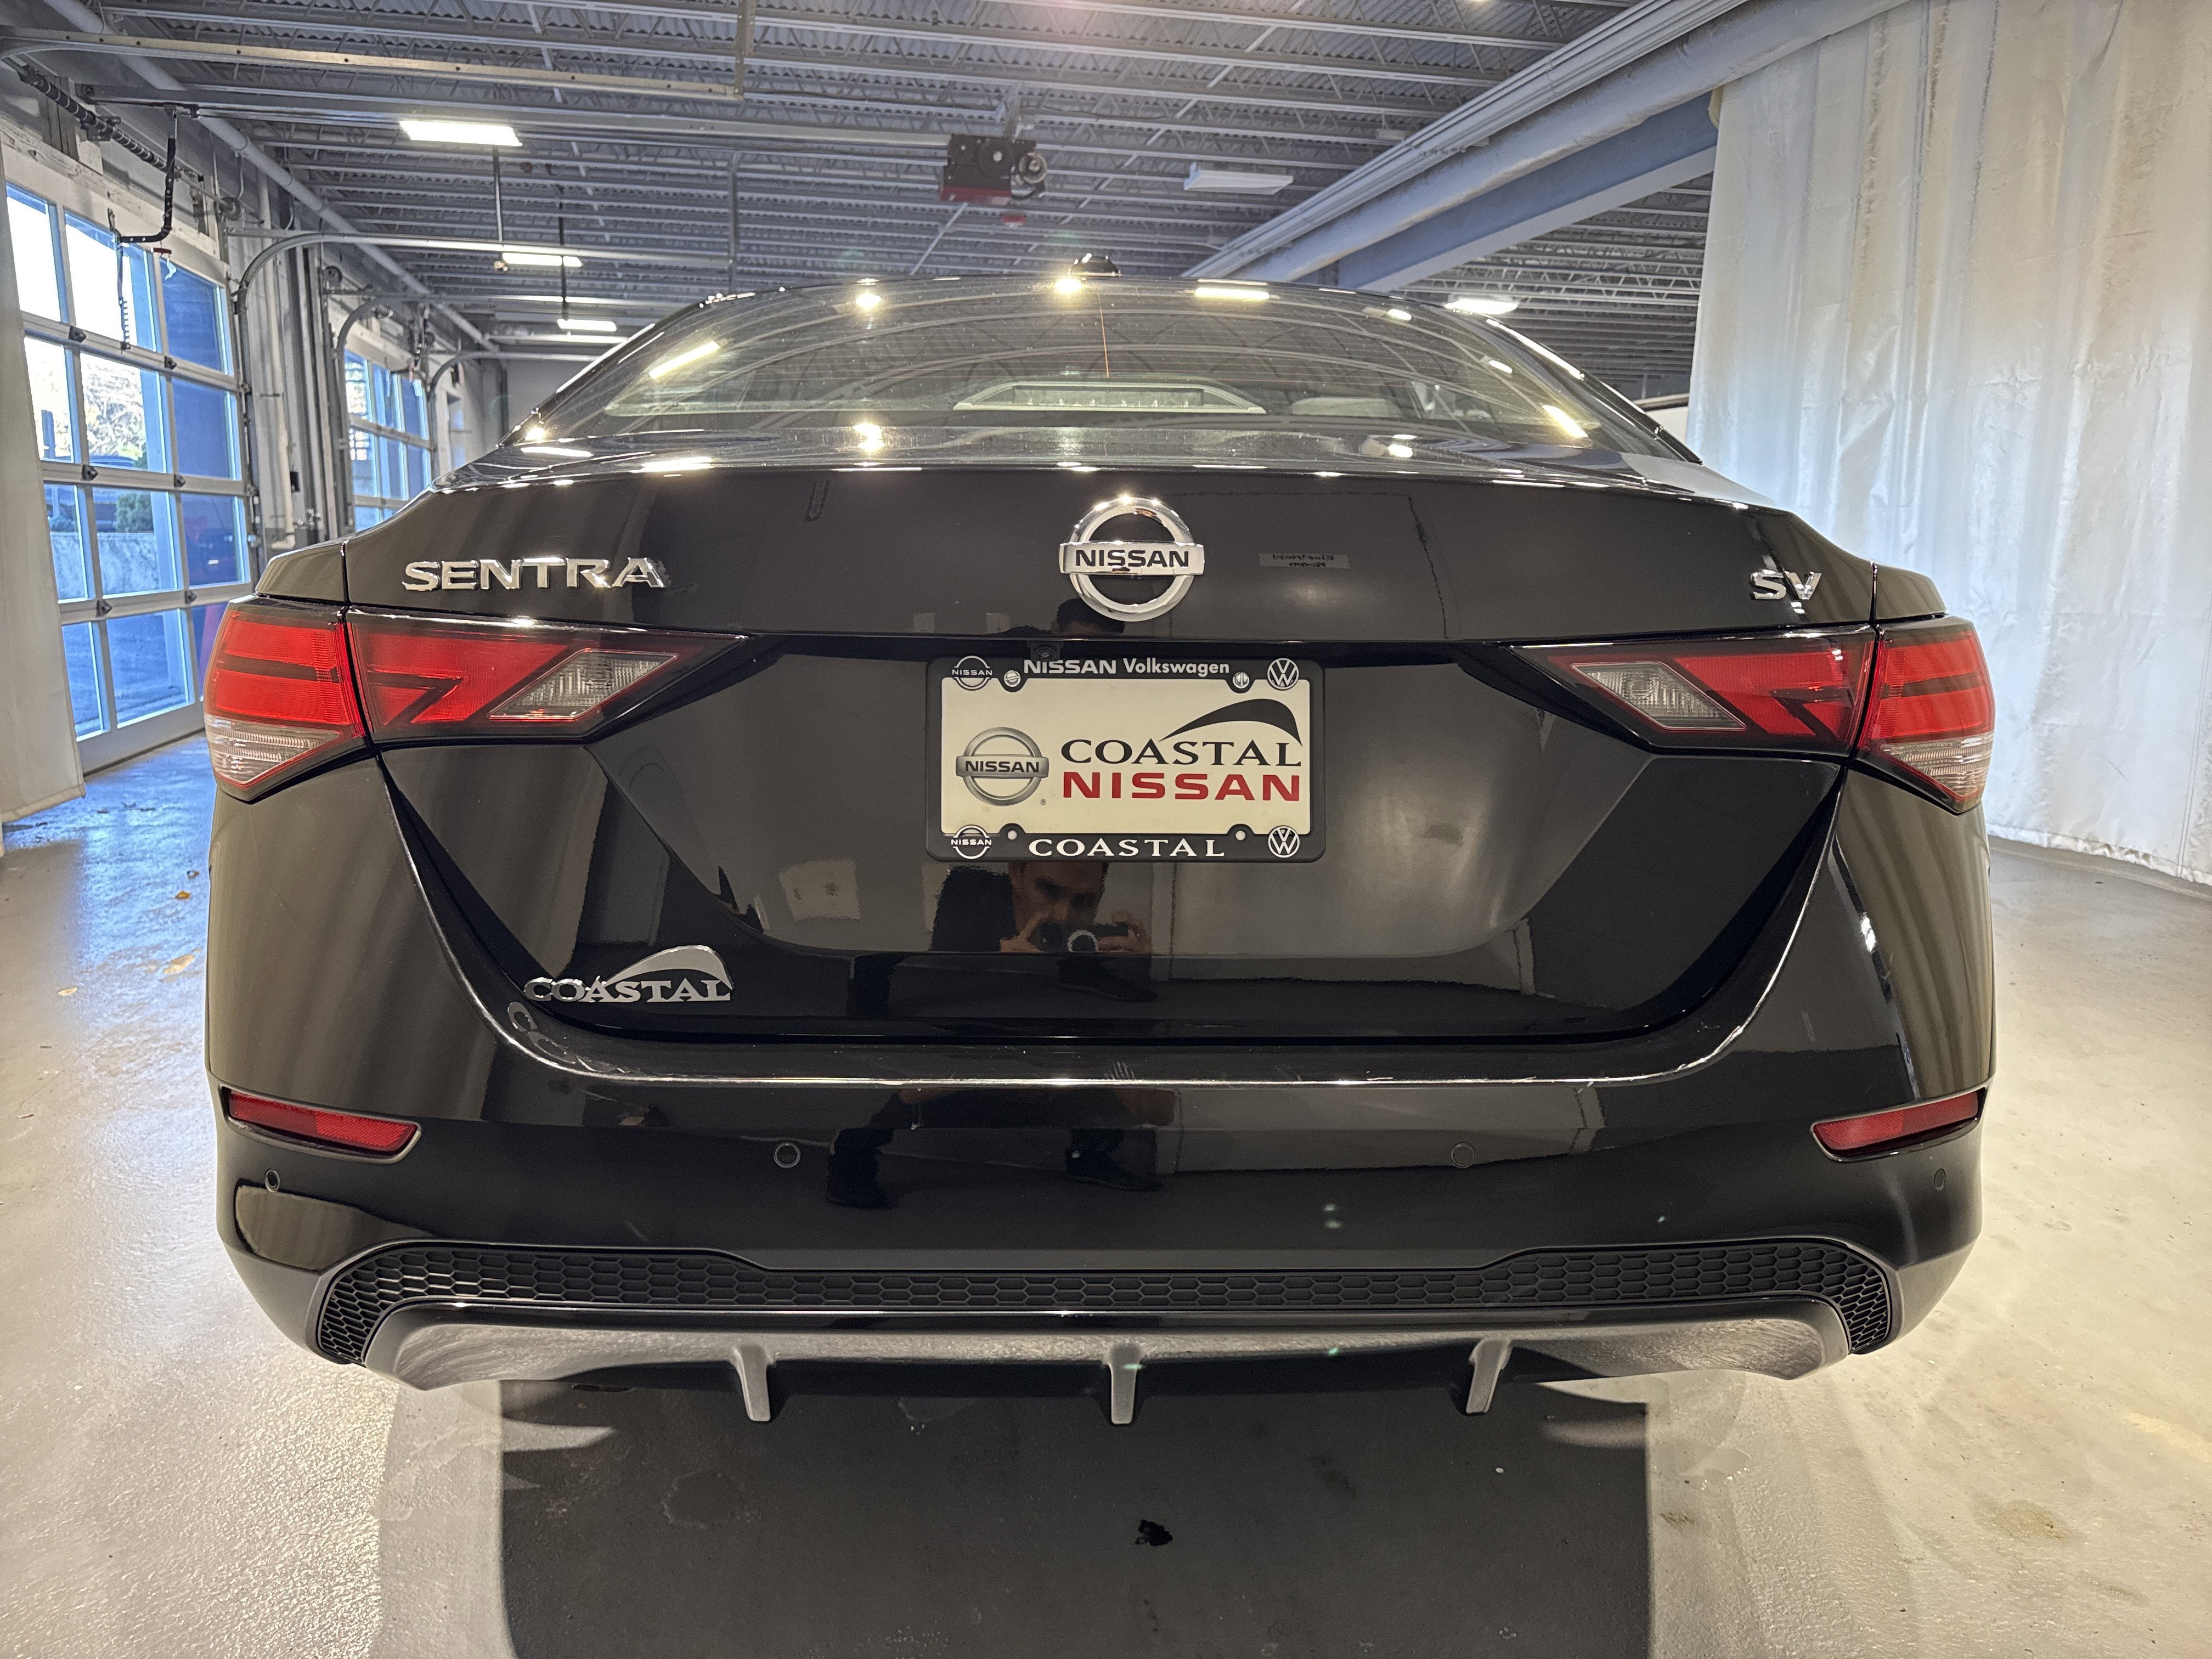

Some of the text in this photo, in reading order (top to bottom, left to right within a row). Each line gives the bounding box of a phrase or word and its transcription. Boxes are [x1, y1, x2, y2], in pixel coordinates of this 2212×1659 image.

[1075, 549, 1189, 567] NISSAN
[402, 556, 665, 591] SENTRA
[1750, 569, 1822, 600] SV
[1024, 658, 1229, 676] NISSAN Volkswagen
[1061, 739, 1301, 767] COASTAL
[965, 760, 1040, 774] NISSAN
[1063, 771, 1300, 802] NISSAN
[951, 838, 992, 847] NISSAN
[1028, 839, 1224, 856] COASTAL
[524, 976, 731, 1003] COASTAL
